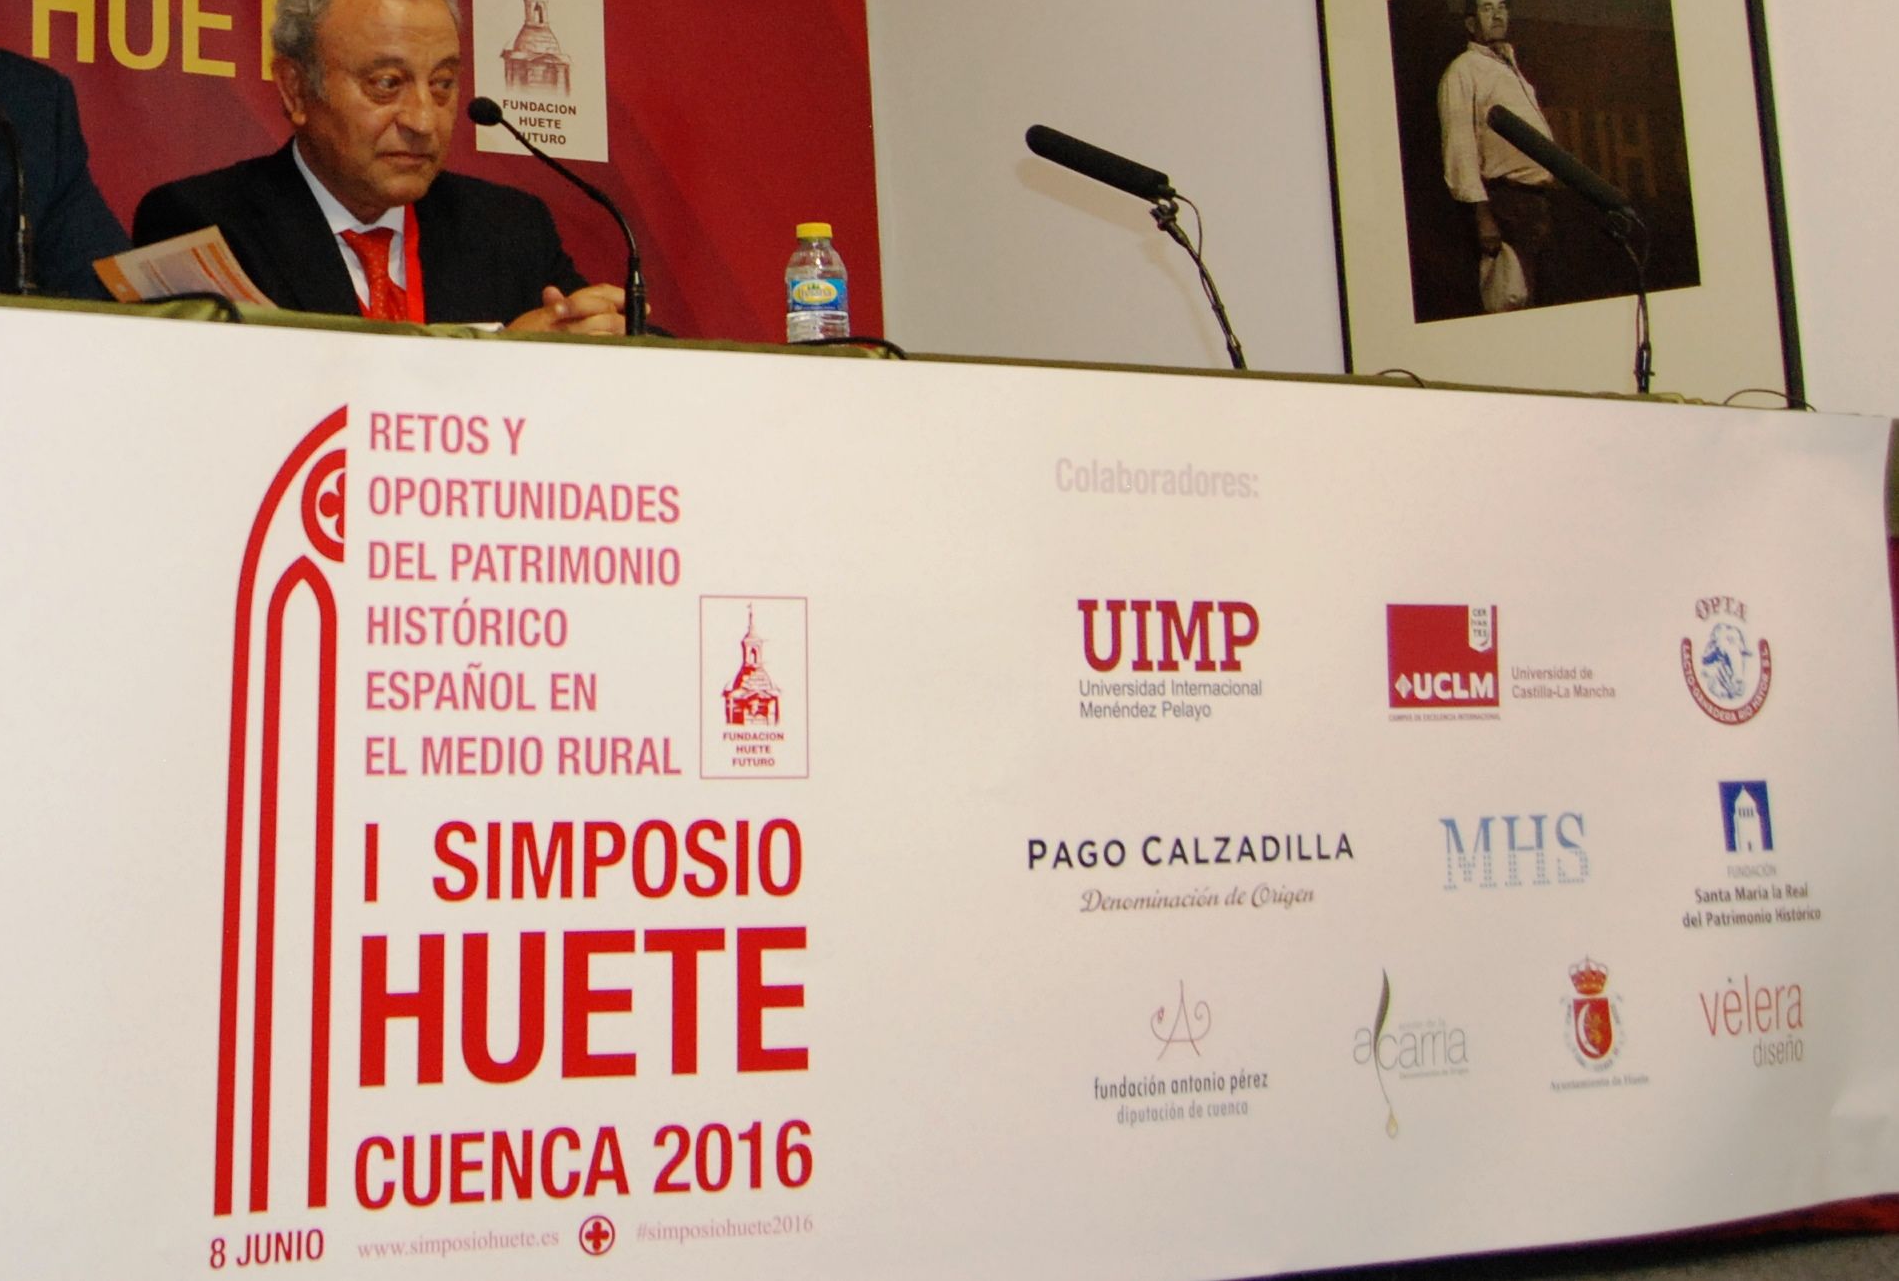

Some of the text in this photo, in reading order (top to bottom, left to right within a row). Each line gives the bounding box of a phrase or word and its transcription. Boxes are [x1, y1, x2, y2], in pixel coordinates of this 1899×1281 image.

[502, 99, 577, 115] FUNDACION
[518, 116, 562, 129] HUETE
[369, 412, 527, 456] RETOS Y
[1055, 457, 1260, 499] Colaboradores:
[368, 476, 681, 524] OPORTUNIDADES
[367, 541, 682, 586] DEL PATRIMONIO
[366, 597, 568, 647] HISTÓRICO
[1695, 596, 1747, 623] OPTA
[1077, 599, 1260, 672] UIMP
[365, 663, 597, 712] ESPAÑOL EN
[1079, 679, 1263, 697] Universidad Internacional
[1412, 672, 1494, 700] UCLM
[1511, 666, 1593, 680] Universidad de
[1511, 684, 1616, 699] Castilla-La Mancha
[1080, 700, 1212, 722] Menéndez Pelayo
[722, 732, 785, 741] FUNDACION
[736, 745, 771, 754] HUETE
[364, 736, 682, 777] EL MEDIO RURAL
[732, 758, 775, 767] FUTURO
[363, 818, 802, 903] I SIMPOSIO
[1027, 832, 1355, 870] PAGO CALZADILLA
[1439, 811, 1591, 890] MHS
[1079, 882, 1315, 913] Denominación de Origen
[1694, 887, 1732, 904] Santa
[1785, 882, 1809, 898] Real
[1682, 911, 1702, 928] del
[1706, 909, 1772, 927] Patrimonio
[359, 926, 809, 1087] HUETE
[1094, 1069, 1269, 1100] fundación antonio pérez
[1117, 1101, 1249, 1126] diputación de cuenca
[354, 1119, 814, 1210] CUENCA 2016
[357, 1228, 560, 1259] www.simposiohuete.es
[635, 1215, 814, 1247] #simposiohuete2016
[209, 1228, 325, 1269] 8 JUNIO
